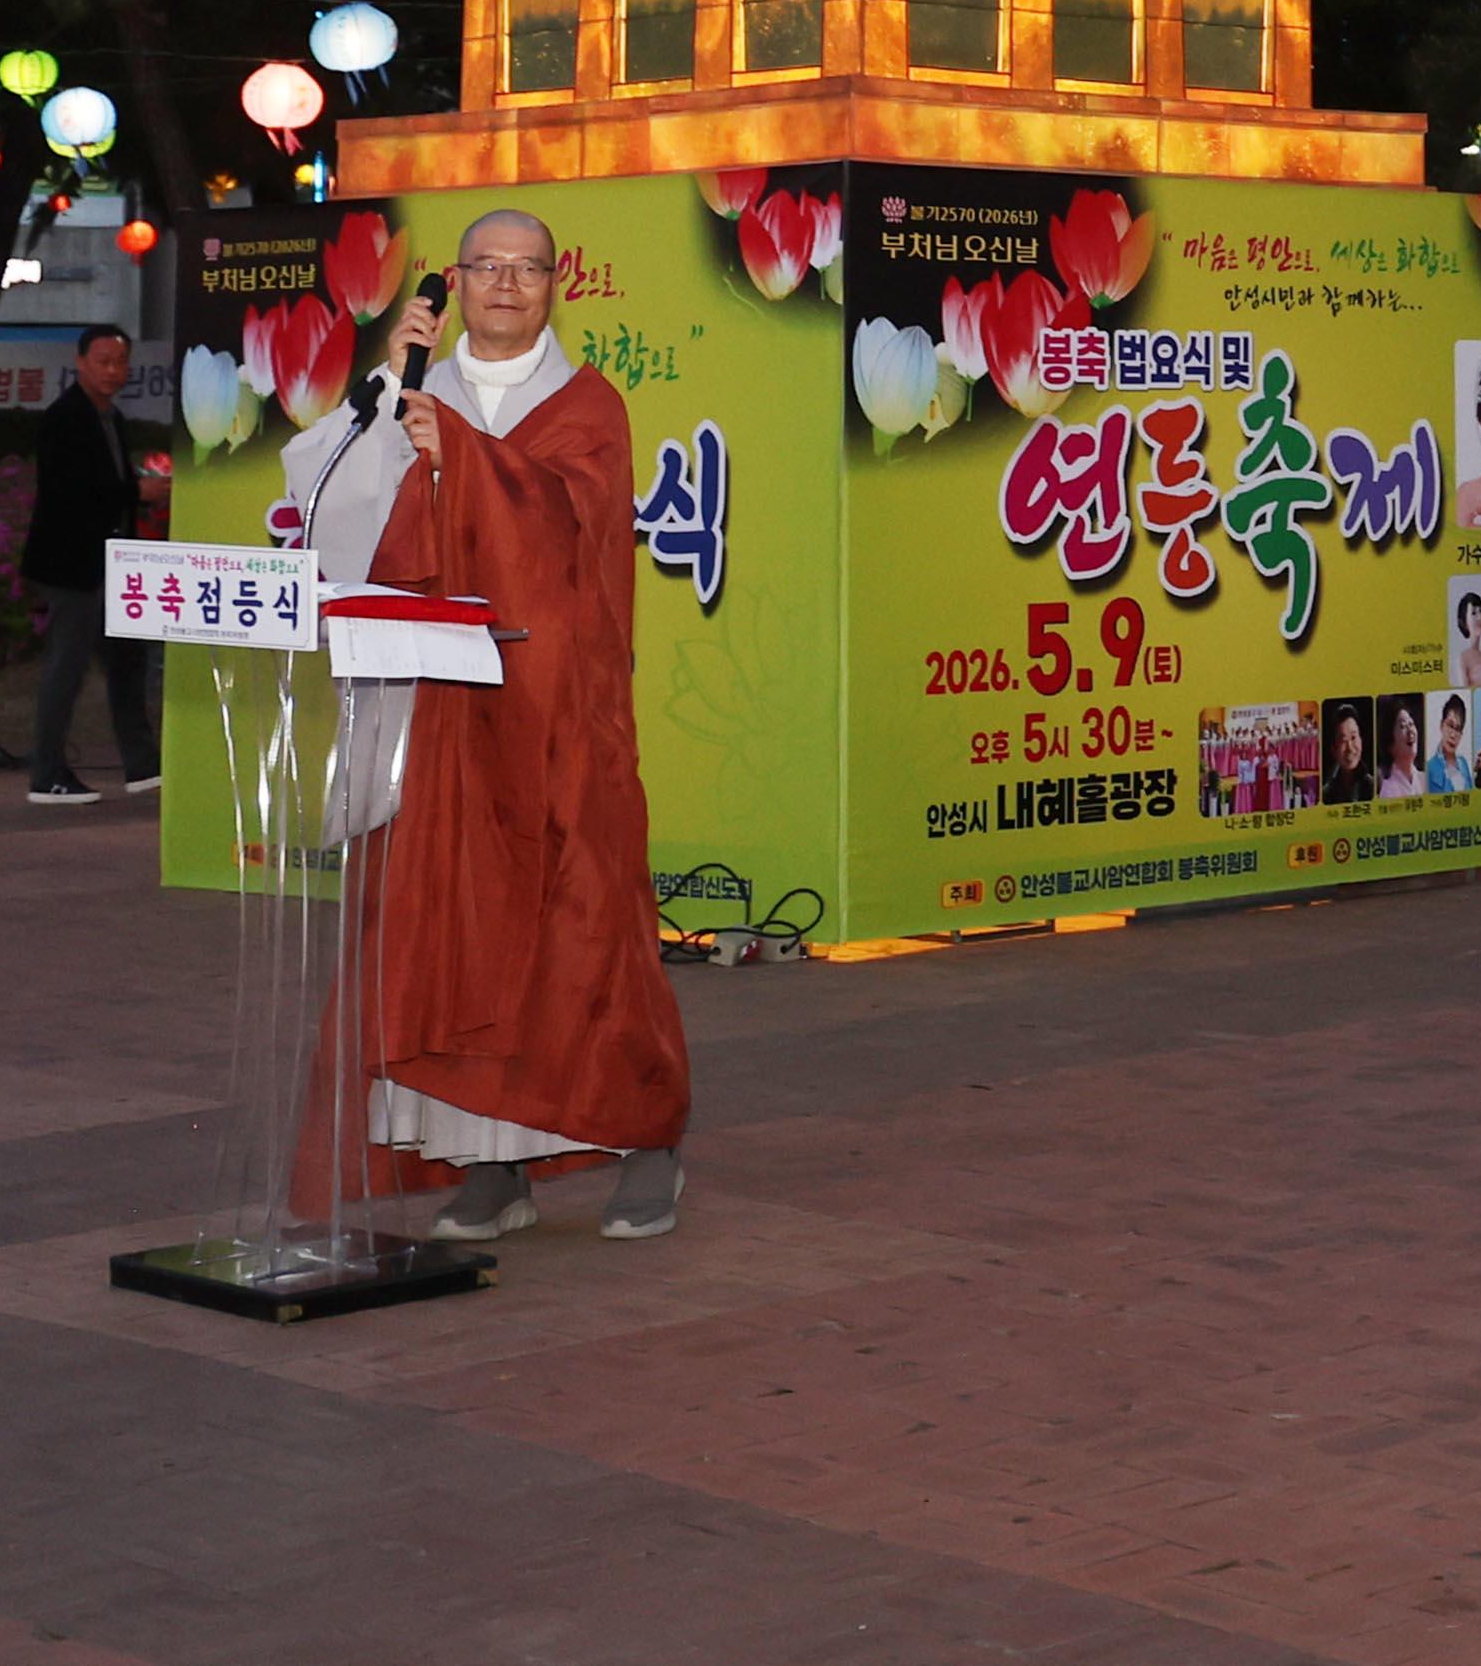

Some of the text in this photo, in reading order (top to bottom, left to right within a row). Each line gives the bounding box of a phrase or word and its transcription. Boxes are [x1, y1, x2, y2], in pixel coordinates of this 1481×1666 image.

[1040, 329, 1253, 389] 봉축 법요식 및
[970, 730, 1010, 764] 오후
[926, 768, 1178, 839] 안성시 내혜홀광장
